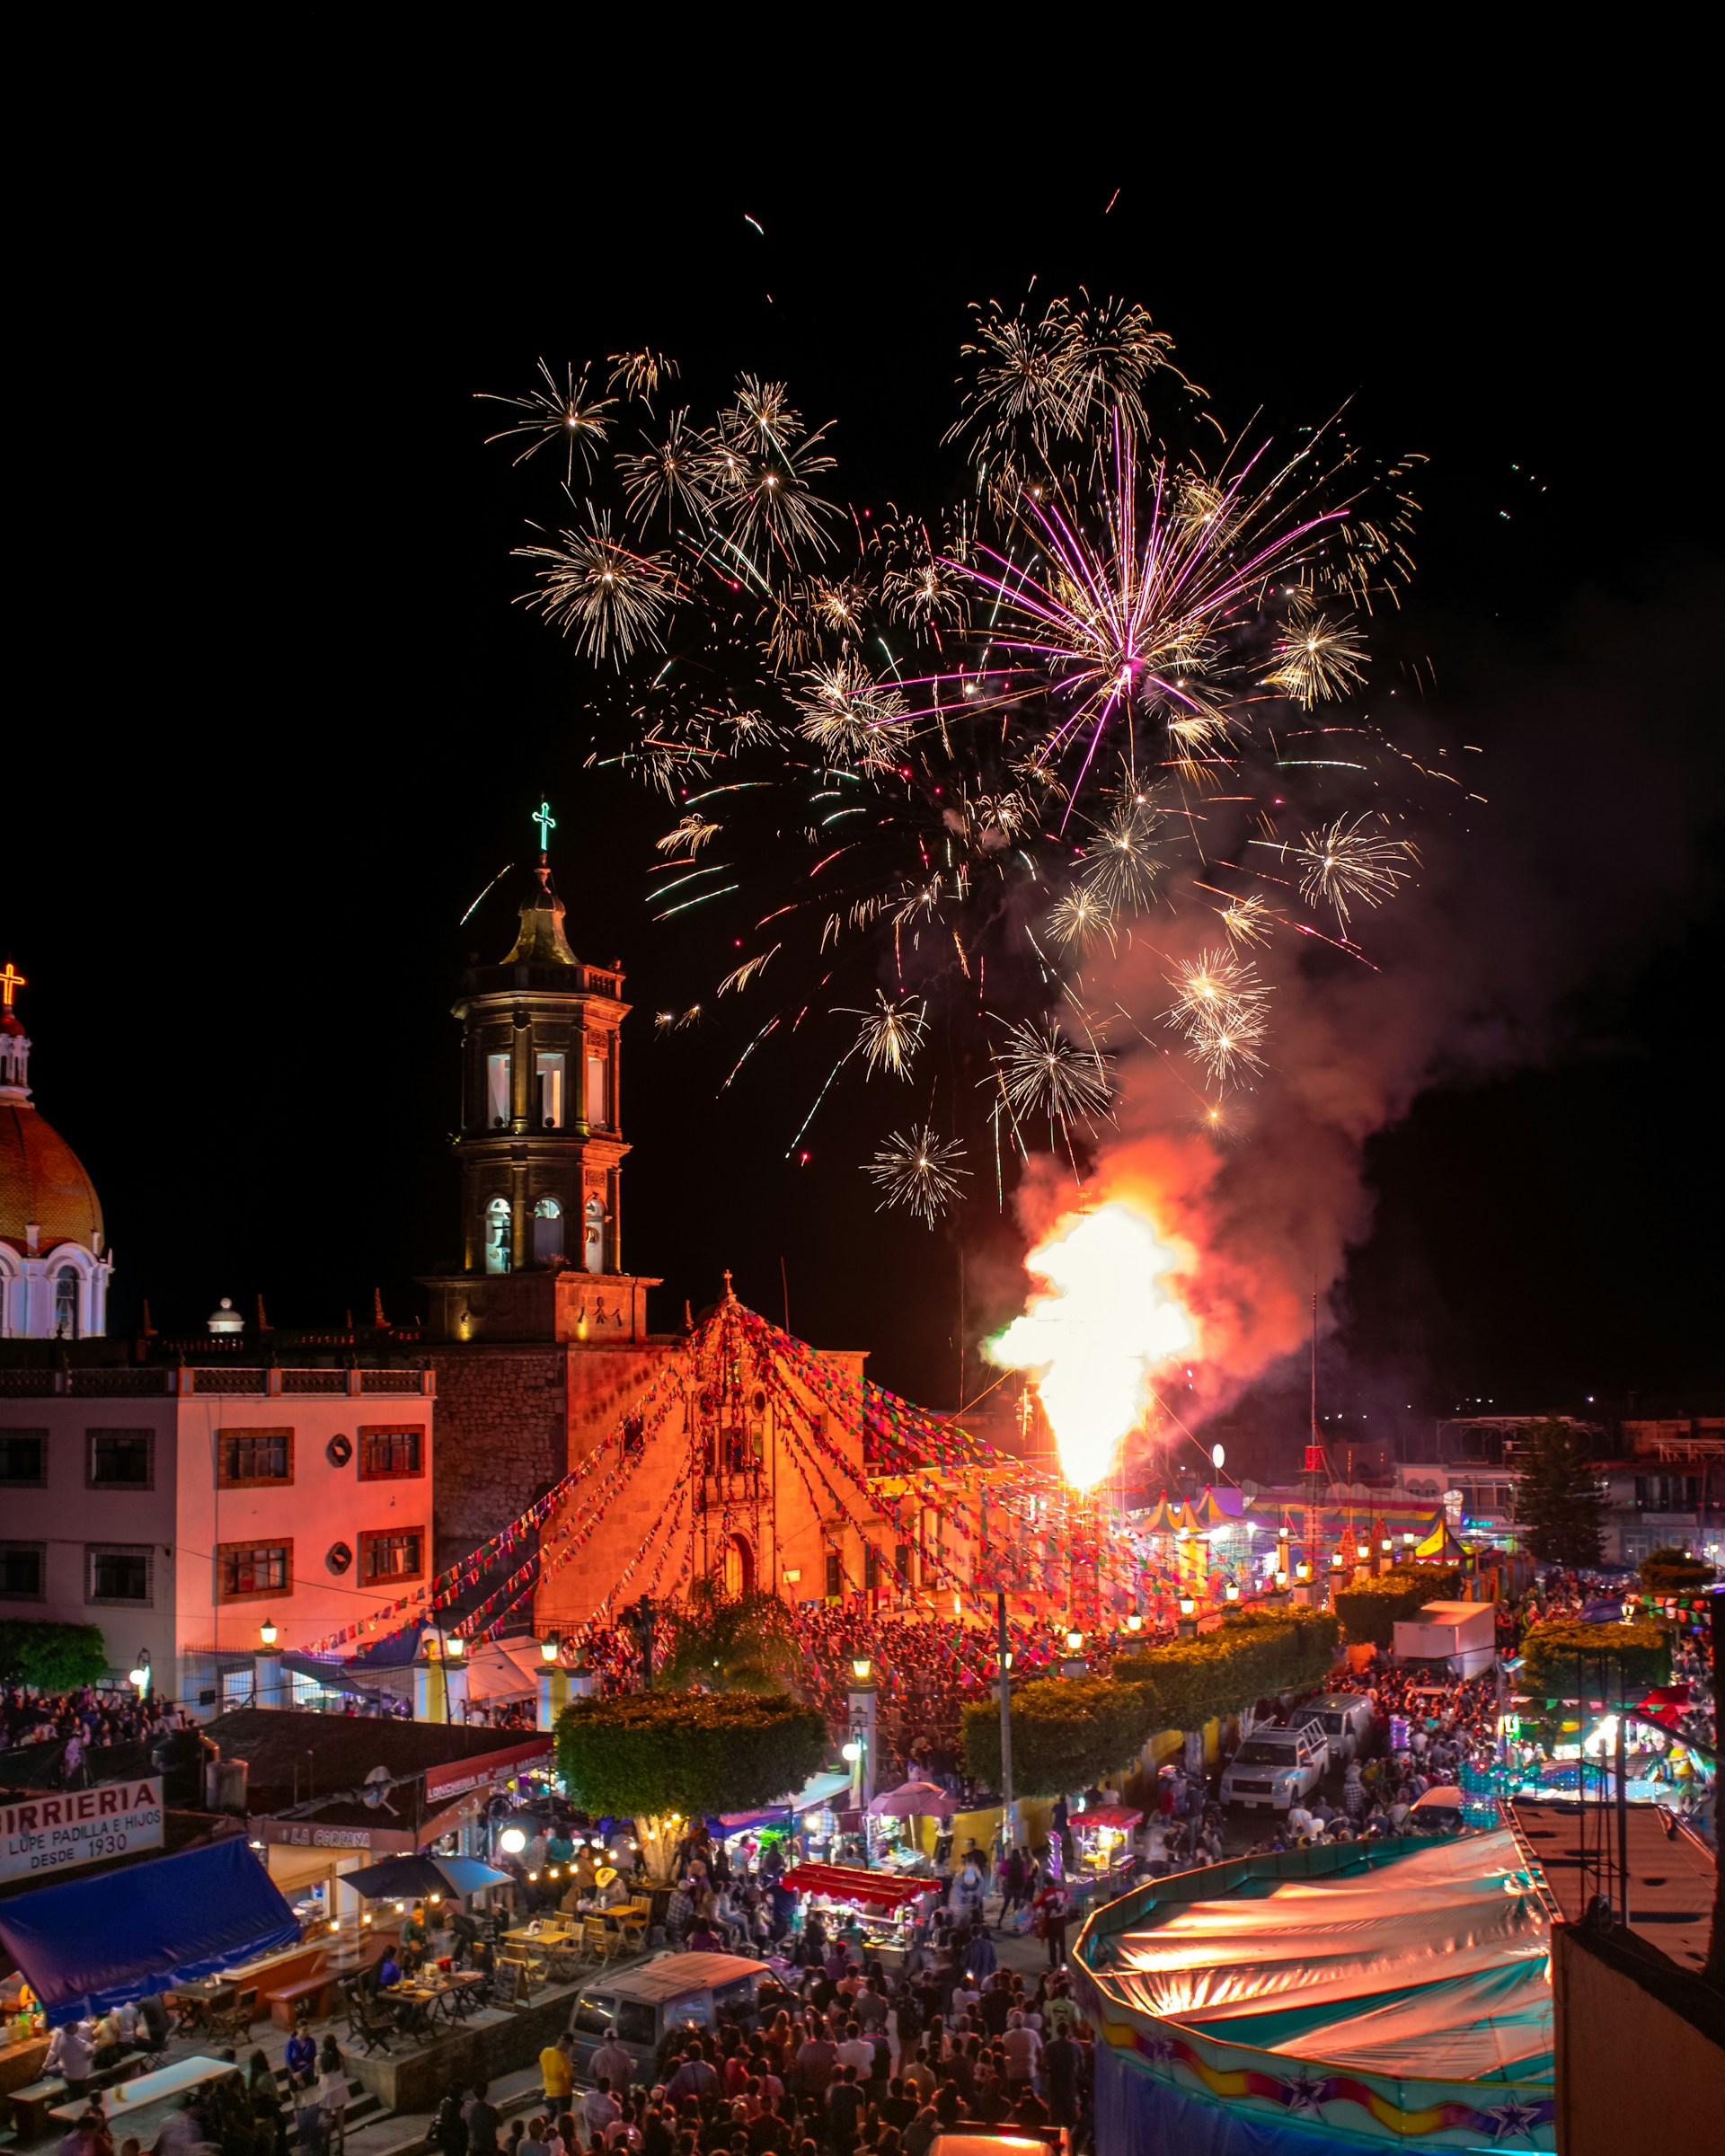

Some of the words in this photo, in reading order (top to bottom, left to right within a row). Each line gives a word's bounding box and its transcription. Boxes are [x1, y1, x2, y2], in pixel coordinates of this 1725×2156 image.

[428, 1776, 476, 1798] LONCHERIA
[477, 1772, 489, 1784] DE
[0, 1783, 155, 1835] IRRIERIA
[9, 1834, 45, 1855] LUPE
[52, 1821, 108, 1846] PADILLA
[113, 1819, 119, 1833] E
[125, 1809, 160, 1830] HIJOS
[290, 1827, 309, 1845] LA
[314, 1829, 370, 1848] COREANA
[31, 1848, 75, 1869] DESDE
[89, 1833, 127, 1858] 1930
